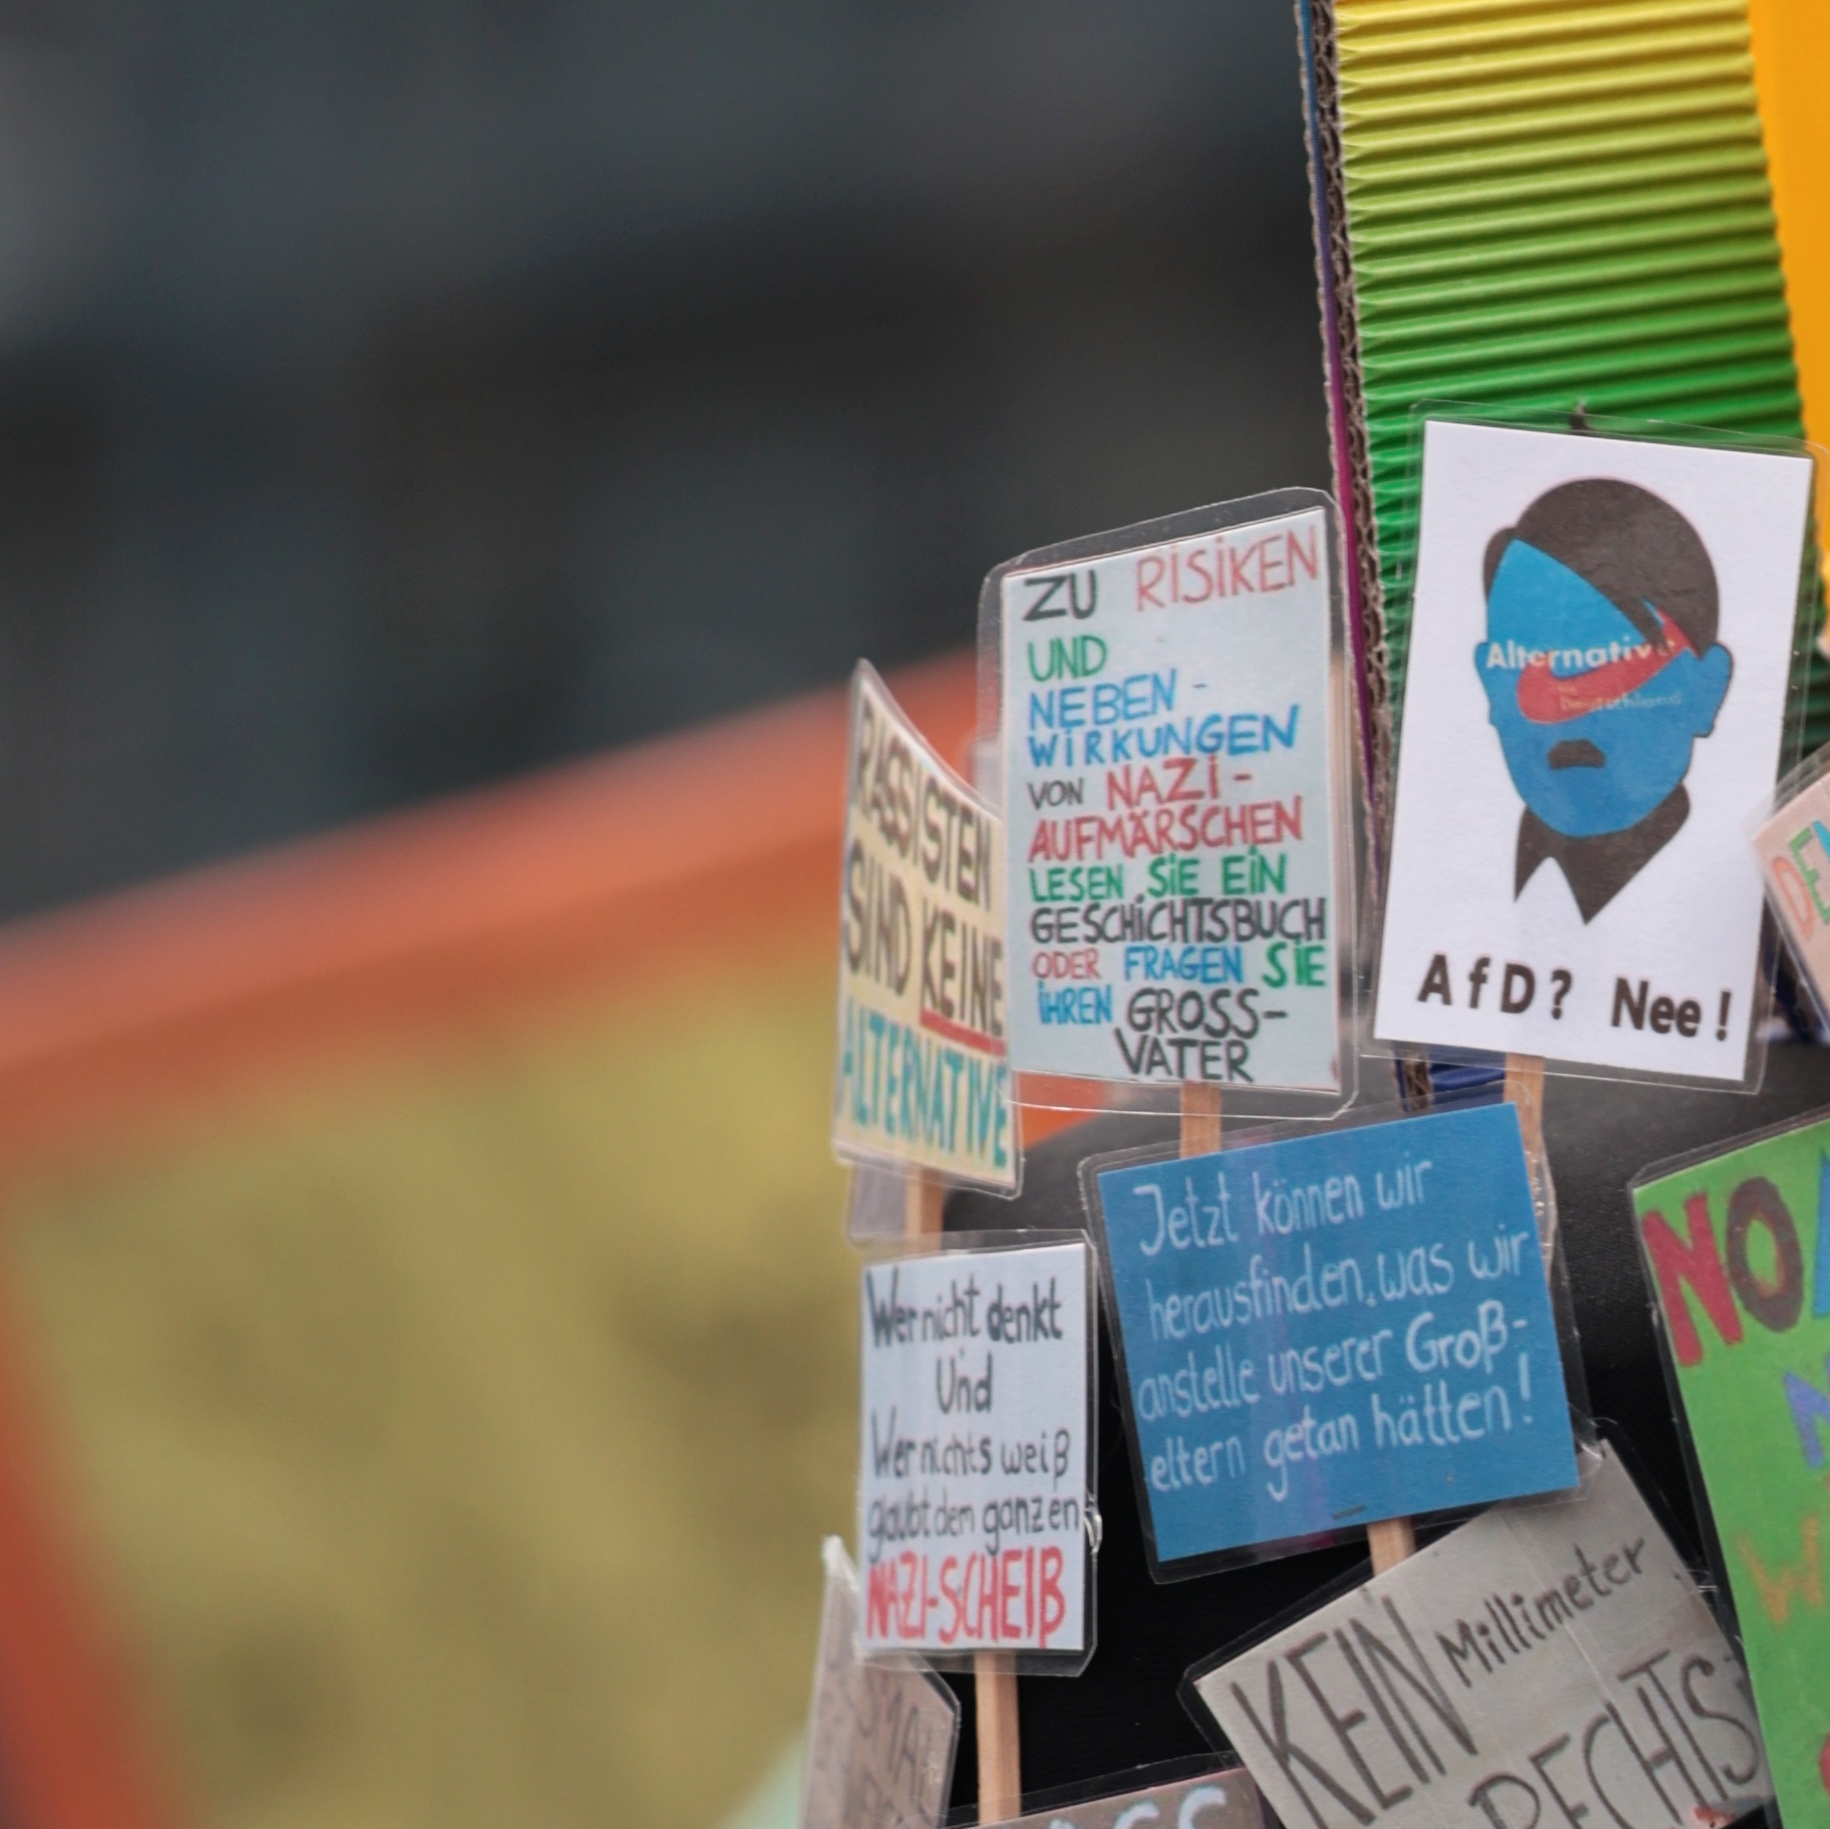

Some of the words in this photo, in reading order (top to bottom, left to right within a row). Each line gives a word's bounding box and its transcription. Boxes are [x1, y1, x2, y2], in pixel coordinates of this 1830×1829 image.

[1022, 570, 1096, 620] ZU
[1027, 635, 1108, 681] UND
[860, 698, 992, 911] RASSISTEN
[1027, 777, 1084, 810] VON
[1028, 795, 1302, 863] AUFMÄRSCHEN
[1029, 863, 1124, 902] LESEN
[847, 838, 912, 997] SIND
[920, 897, 1003, 1037] KEINE
[1032, 948, 1101, 979] ODER
[1123, 945, 1243, 984] FRAGEN
[1417, 954, 1572, 1019] AfD?
[1611, 977, 1730, 1042] Nee!
[838, 998, 1007, 1167] ALTERNATIVE
[1114, 1028, 1254, 1082] VATER
[1133, 1170, 1240, 1257] Jetzt
[1252, 1170, 1364, 1235] können
[1376, 1151, 1433, 1210] wir
[1377, 1242, 1455, 1304] was
[1468, 1225, 1530, 1281] wir
[867, 1267, 917, 1348] Wer
[922, 1273, 981, 1339] nicht
[986, 1277, 1063, 1344] denkt
[936, 1351, 993, 1414] Und
[1137, 1341, 1261, 1422] anstelle
[1268, 1329, 1393, 1394] unserer
[871, 1405, 917, 1479] Wer
[921, 1432, 992, 1467] nichts
[1000, 1428, 1070, 1492] weiß
[1150, 1435, 1246, 1492] eltern
[1263, 1405, 1361, 1501] getan
[1371, 1353, 1533, 1448] hätten!
[867, 1489, 932, 1564] glaubt
[934, 1488, 976, 1539] dem
[981, 1494, 1080, 1556] ganzen
[1436, 1536, 1646, 1688] Millimeter
